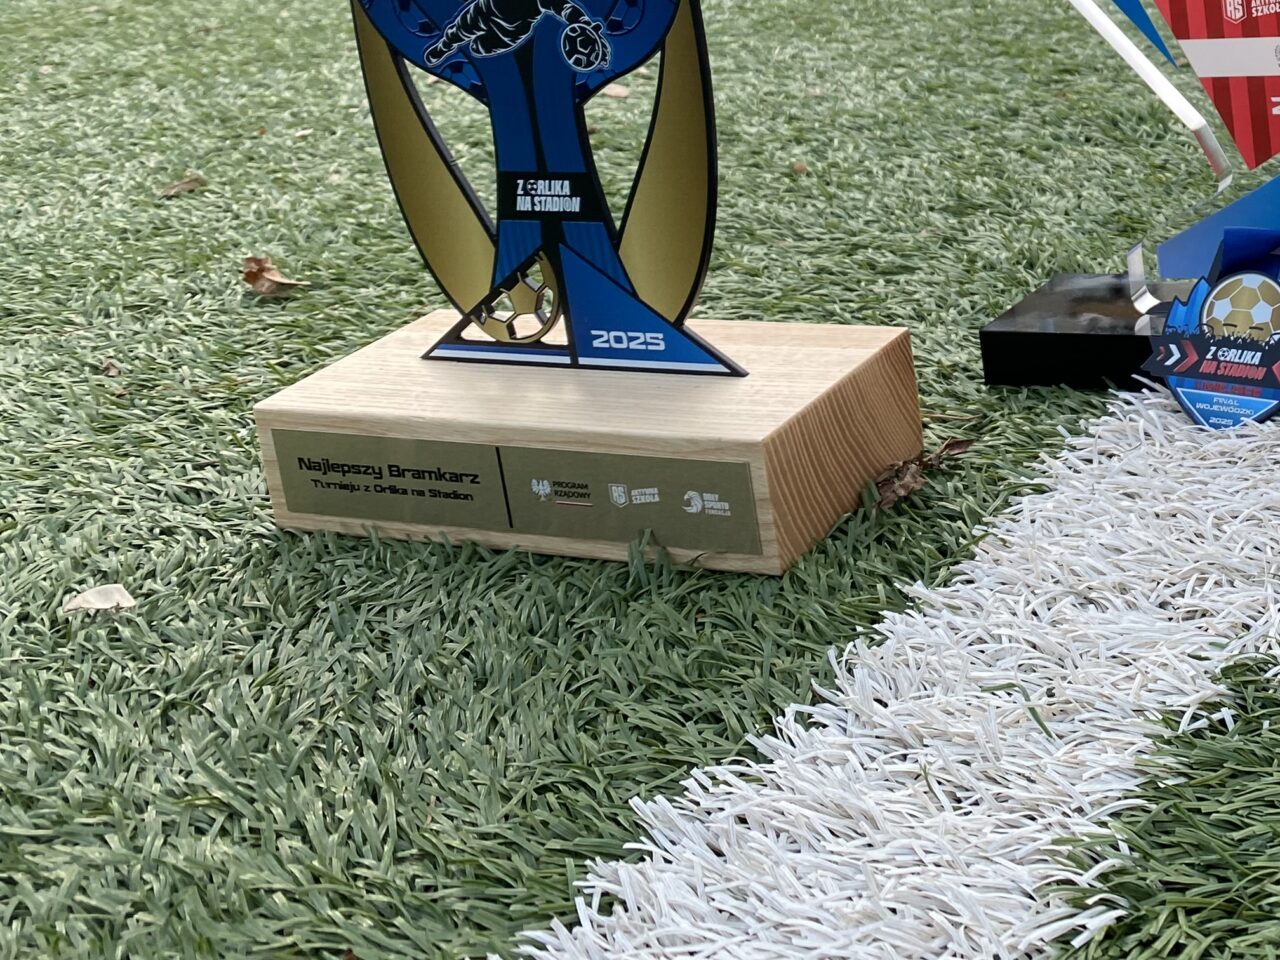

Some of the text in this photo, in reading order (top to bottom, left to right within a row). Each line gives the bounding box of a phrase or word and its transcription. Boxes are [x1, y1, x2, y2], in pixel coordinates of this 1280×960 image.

[516, 179, 525, 195] Z
[516, 196, 581, 212] NA STADION
[590, 330, 666, 350] 2025
[1205, 346, 1217, 359] Z
[1199, 360, 1267, 380] NA STADION
[1209, 416, 1233, 425] 2025
[297, 457, 480, 484] Najlepszy Bramkarz
[311, 478, 361, 493] Turnieju
[374, 484, 408, 496] Orlika
[411, 488, 425, 497] na
[428, 489, 474, 501] Stadion
[552, 481, 588, 489] PROGRAM
[554, 490, 591, 499] RZĄDOWY
